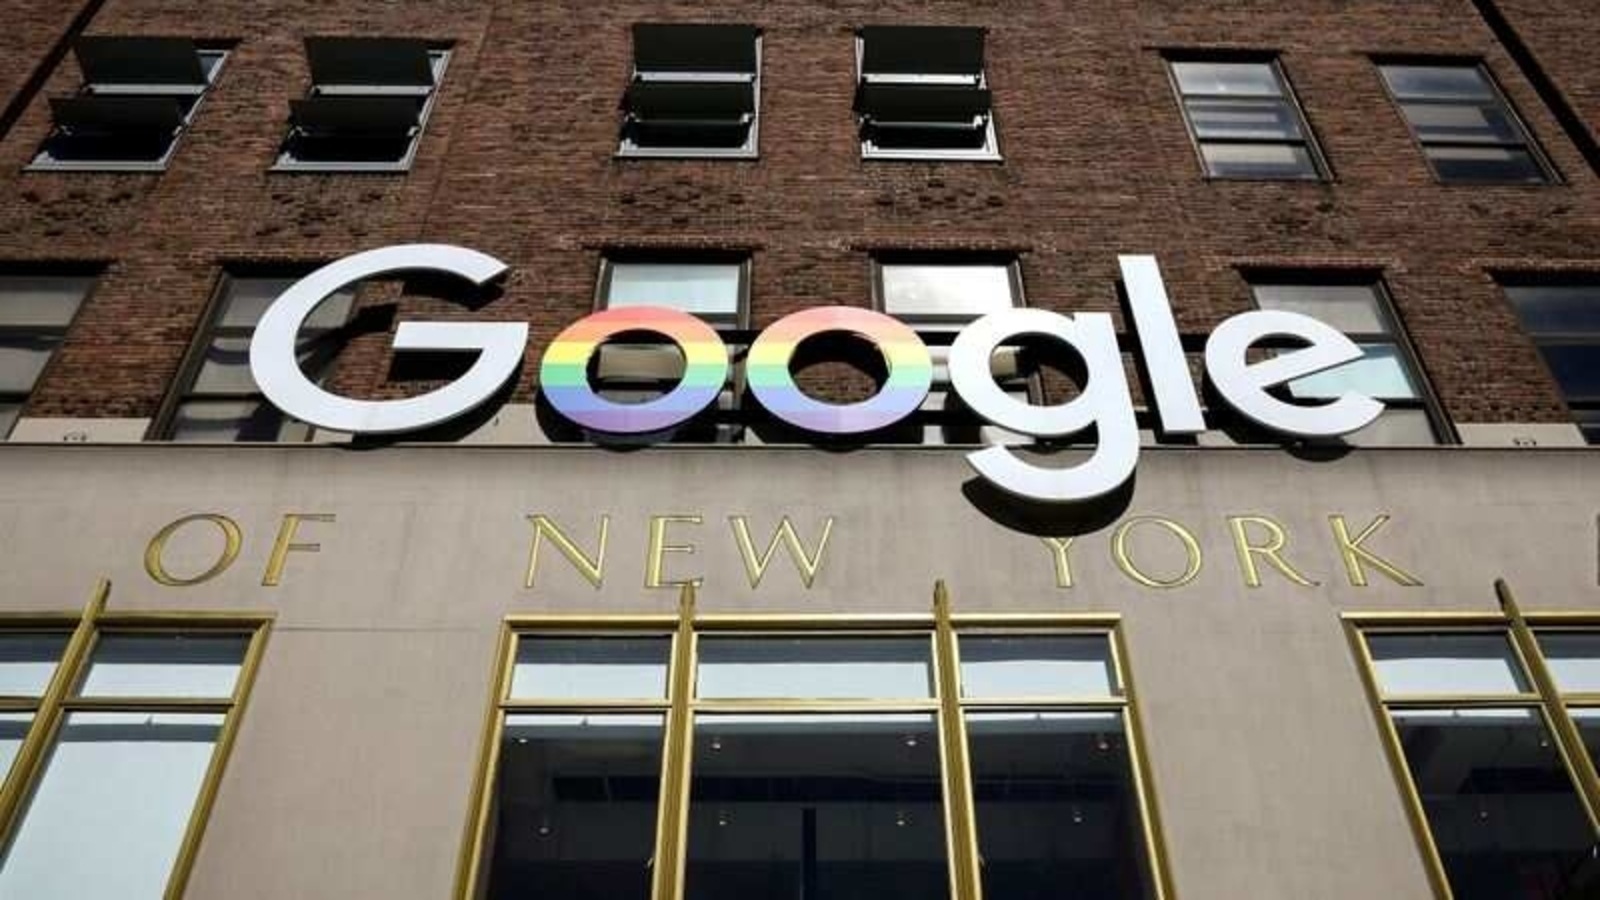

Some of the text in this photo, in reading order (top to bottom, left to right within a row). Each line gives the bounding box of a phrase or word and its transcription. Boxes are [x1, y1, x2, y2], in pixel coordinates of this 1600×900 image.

[250, 243, 1385, 502] Google
[143, 513, 1423, 588] OF NEW YORK
